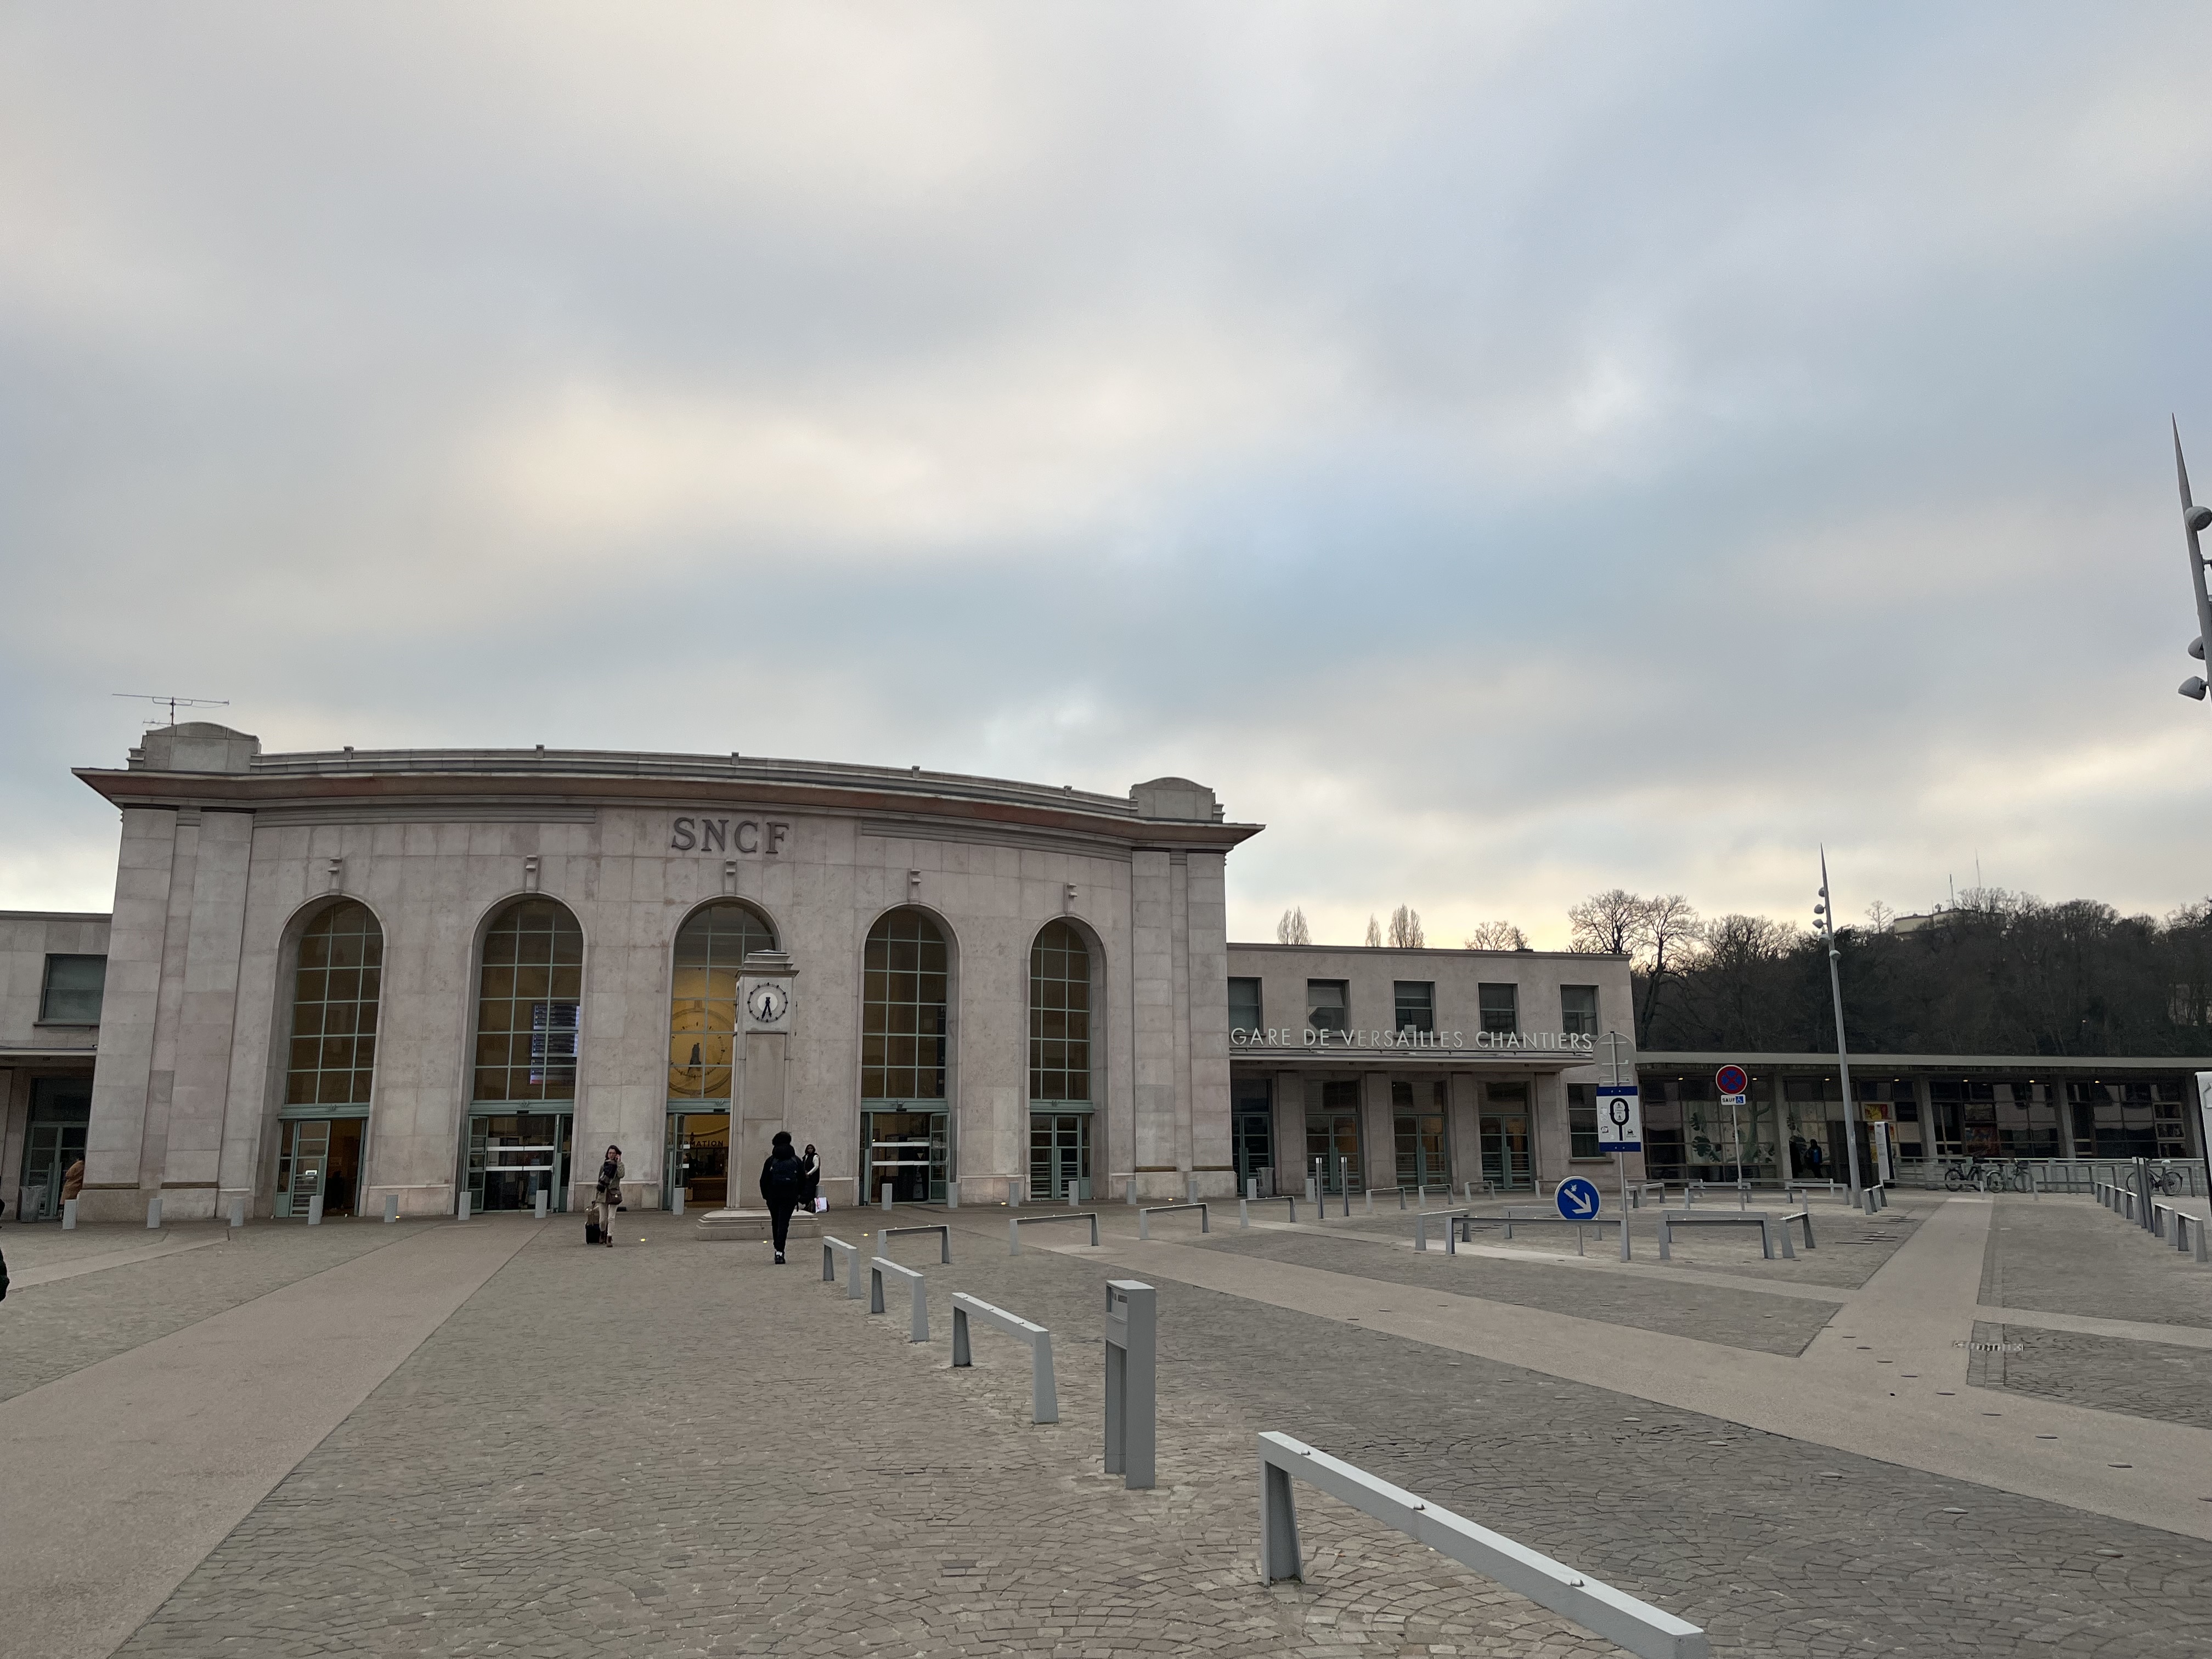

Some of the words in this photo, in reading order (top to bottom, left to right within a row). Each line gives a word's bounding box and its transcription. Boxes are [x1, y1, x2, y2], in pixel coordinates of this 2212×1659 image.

[671, 817, 789, 854] SNCF
[1231, 1027, 1291, 1046] GARE
[1304, 1028, 1330, 1047] DE
[1340, 1029, 1463, 1048] VERSAILLES
[1475, 1031, 1592, 1050] CHANTIERS
